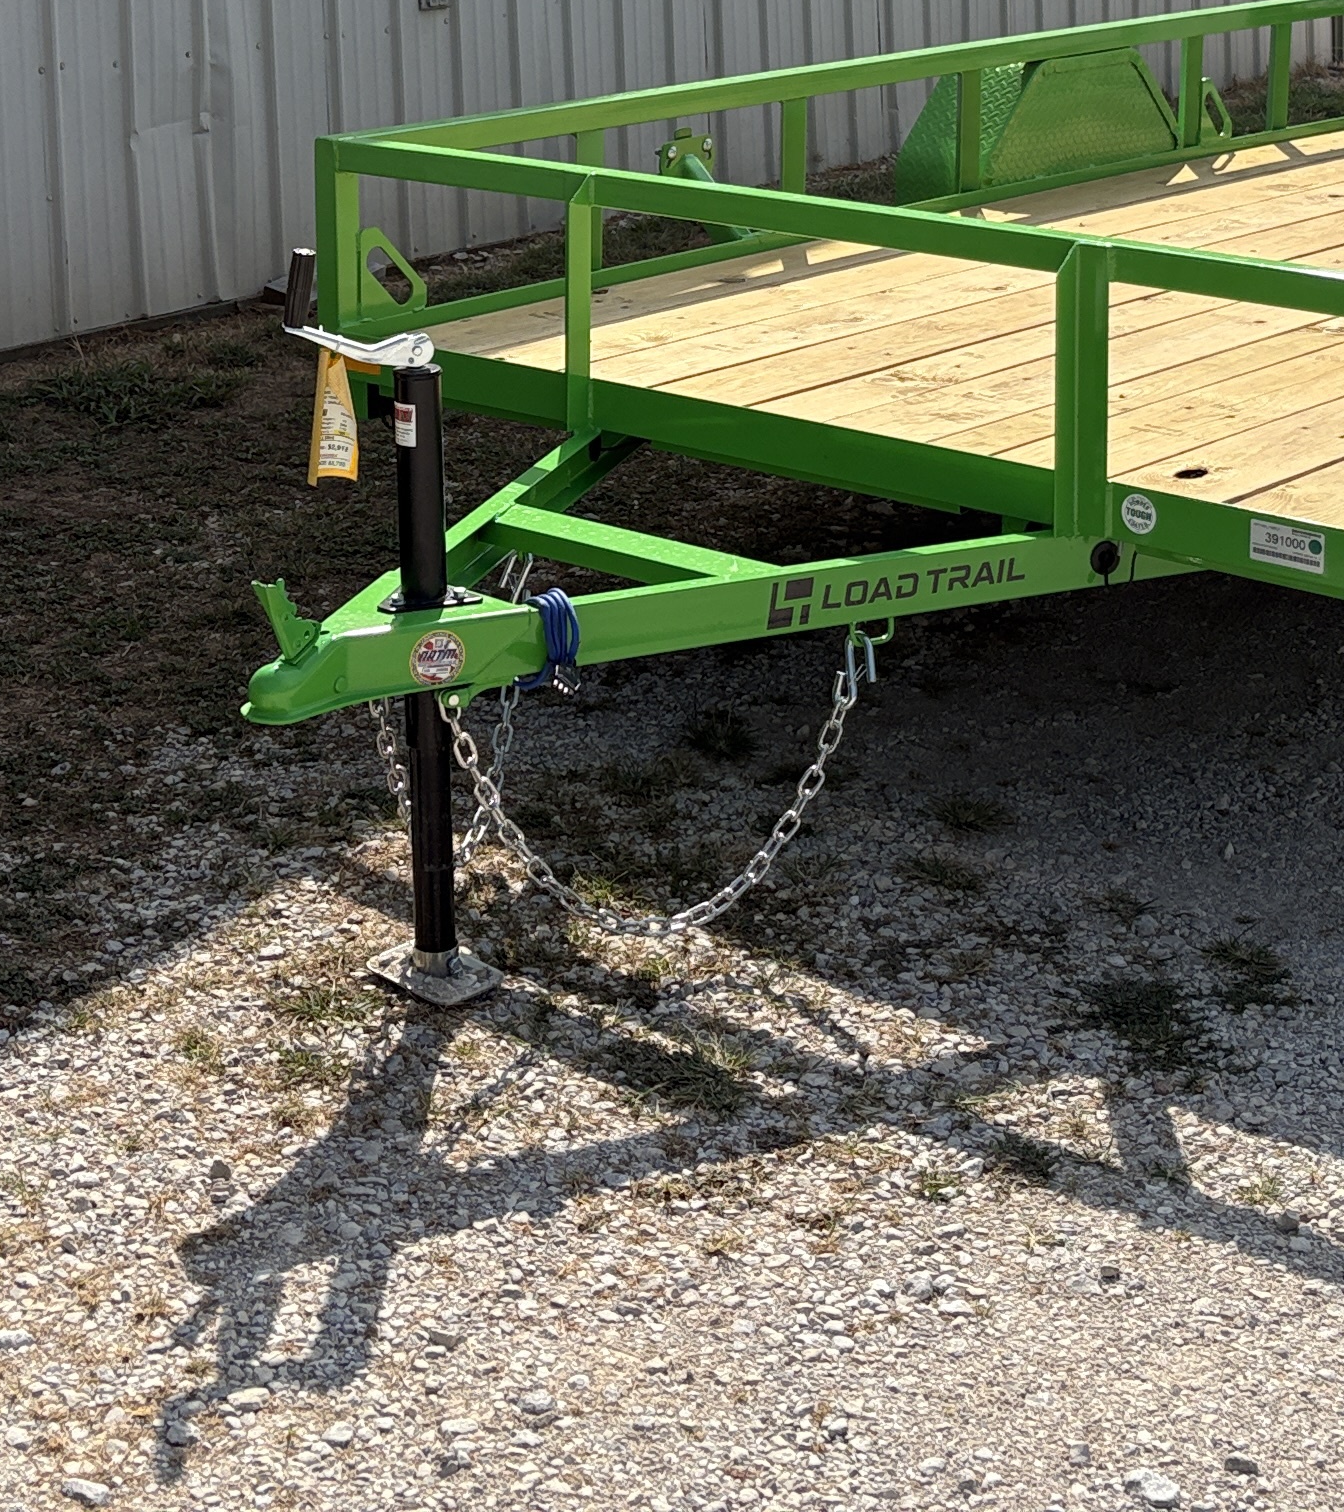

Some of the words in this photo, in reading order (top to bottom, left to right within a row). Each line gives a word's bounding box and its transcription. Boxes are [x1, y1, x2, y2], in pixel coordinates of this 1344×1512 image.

[1264, 531, 1306, 551] 391000
[820, 572, 919, 611] LOAD
[926, 557, 1026, 595] TRAIL
